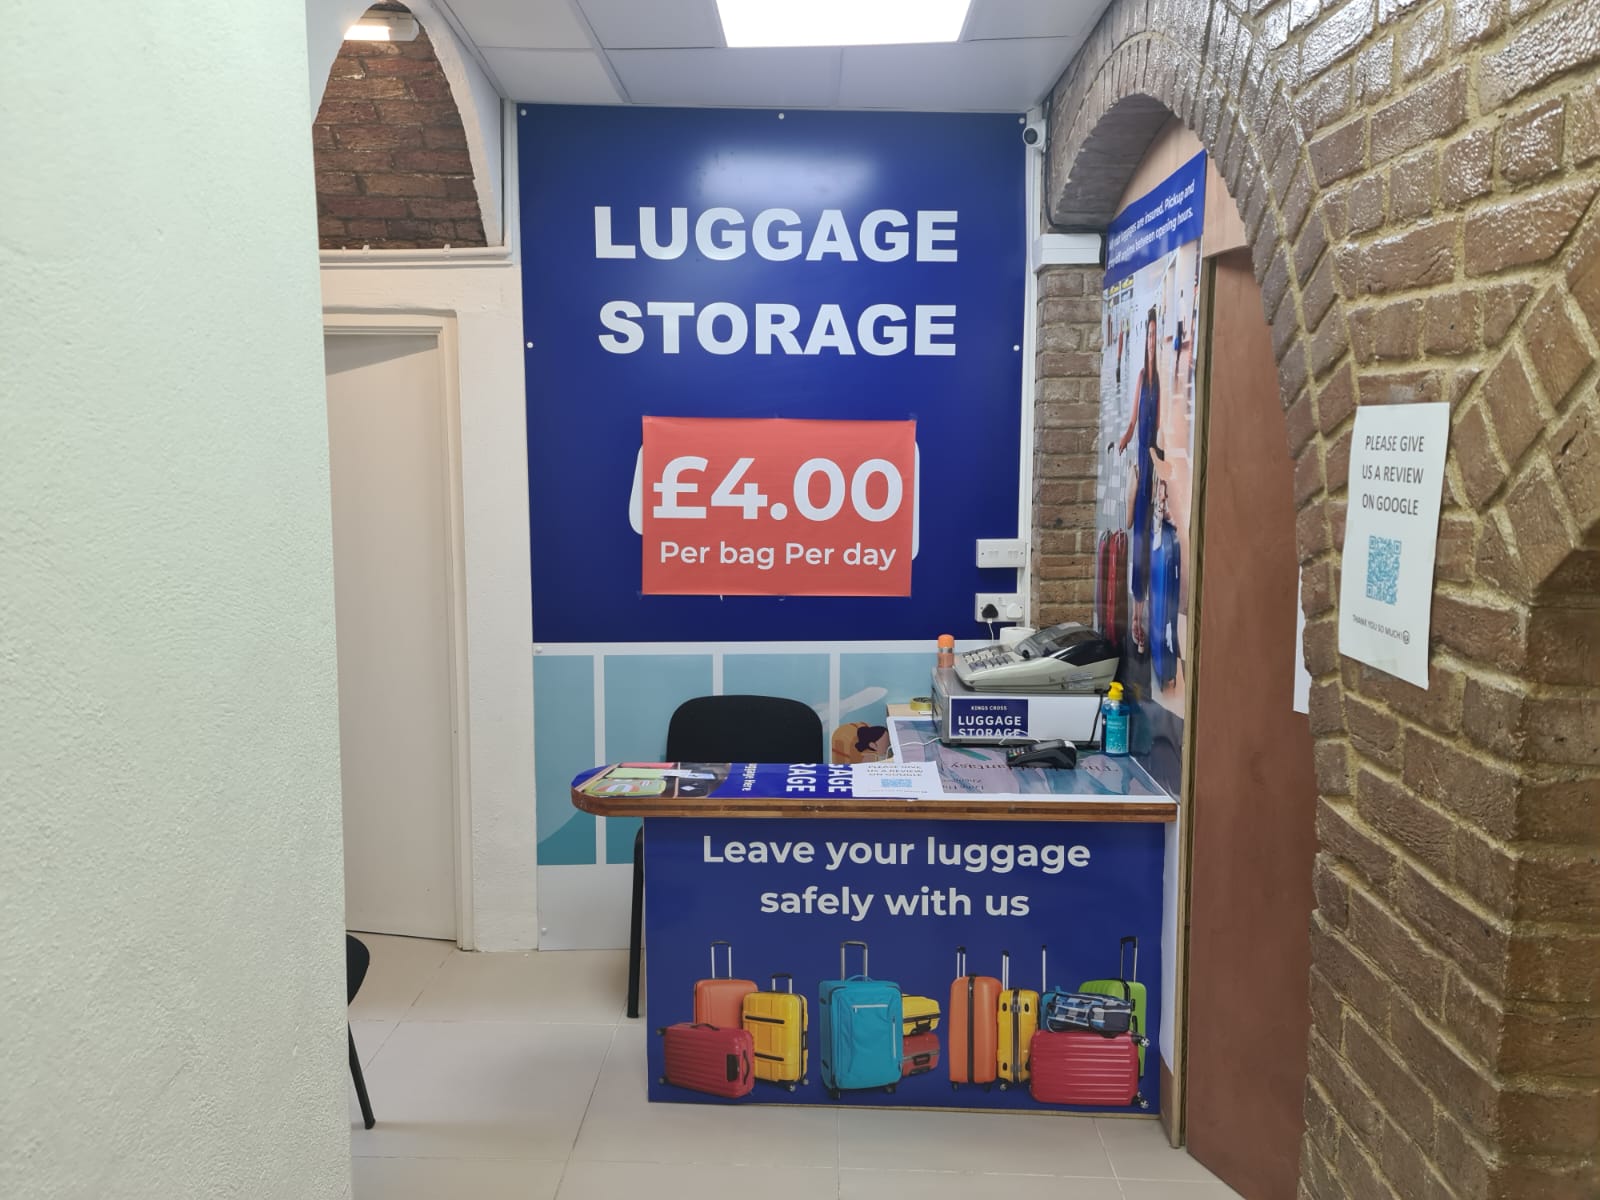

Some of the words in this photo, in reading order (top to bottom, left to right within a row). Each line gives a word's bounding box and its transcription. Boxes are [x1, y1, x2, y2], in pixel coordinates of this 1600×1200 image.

[1183, 178, 1195, 199] and
[594, 206, 958, 262] LUGGAGE
[1155, 217, 1177, 239] opening
[598, 301, 957, 356] STORAGE
[1365, 435, 1398, 452] PLEASE
[1399, 435, 1425, 453] GIVE
[1362, 463, 1373, 480] US
[1374, 465, 1381, 481] A
[1383, 466, 1424, 485] REVIEW
[653, 456, 903, 522] £4.00
[1362, 493, 1375, 510] ON
[1376, 495, 1419, 516] GOOGLE
[660, 541, 710, 564] Per
[720, 541, 775, 570] bag
[785, 543, 835, 565] Per
[843, 542, 897, 571] day
[958, 715, 1022, 726] LUGGAGE
[958, 728, 1021, 737] STORAGE
[703, 835, 815, 863] Leave
[825, 841, 914, 871] your
[927, 836, 1091, 873] luggage
[760, 886, 874, 921] safely
[885, 886, 972, 916] with
[985, 894, 1030, 916] us
